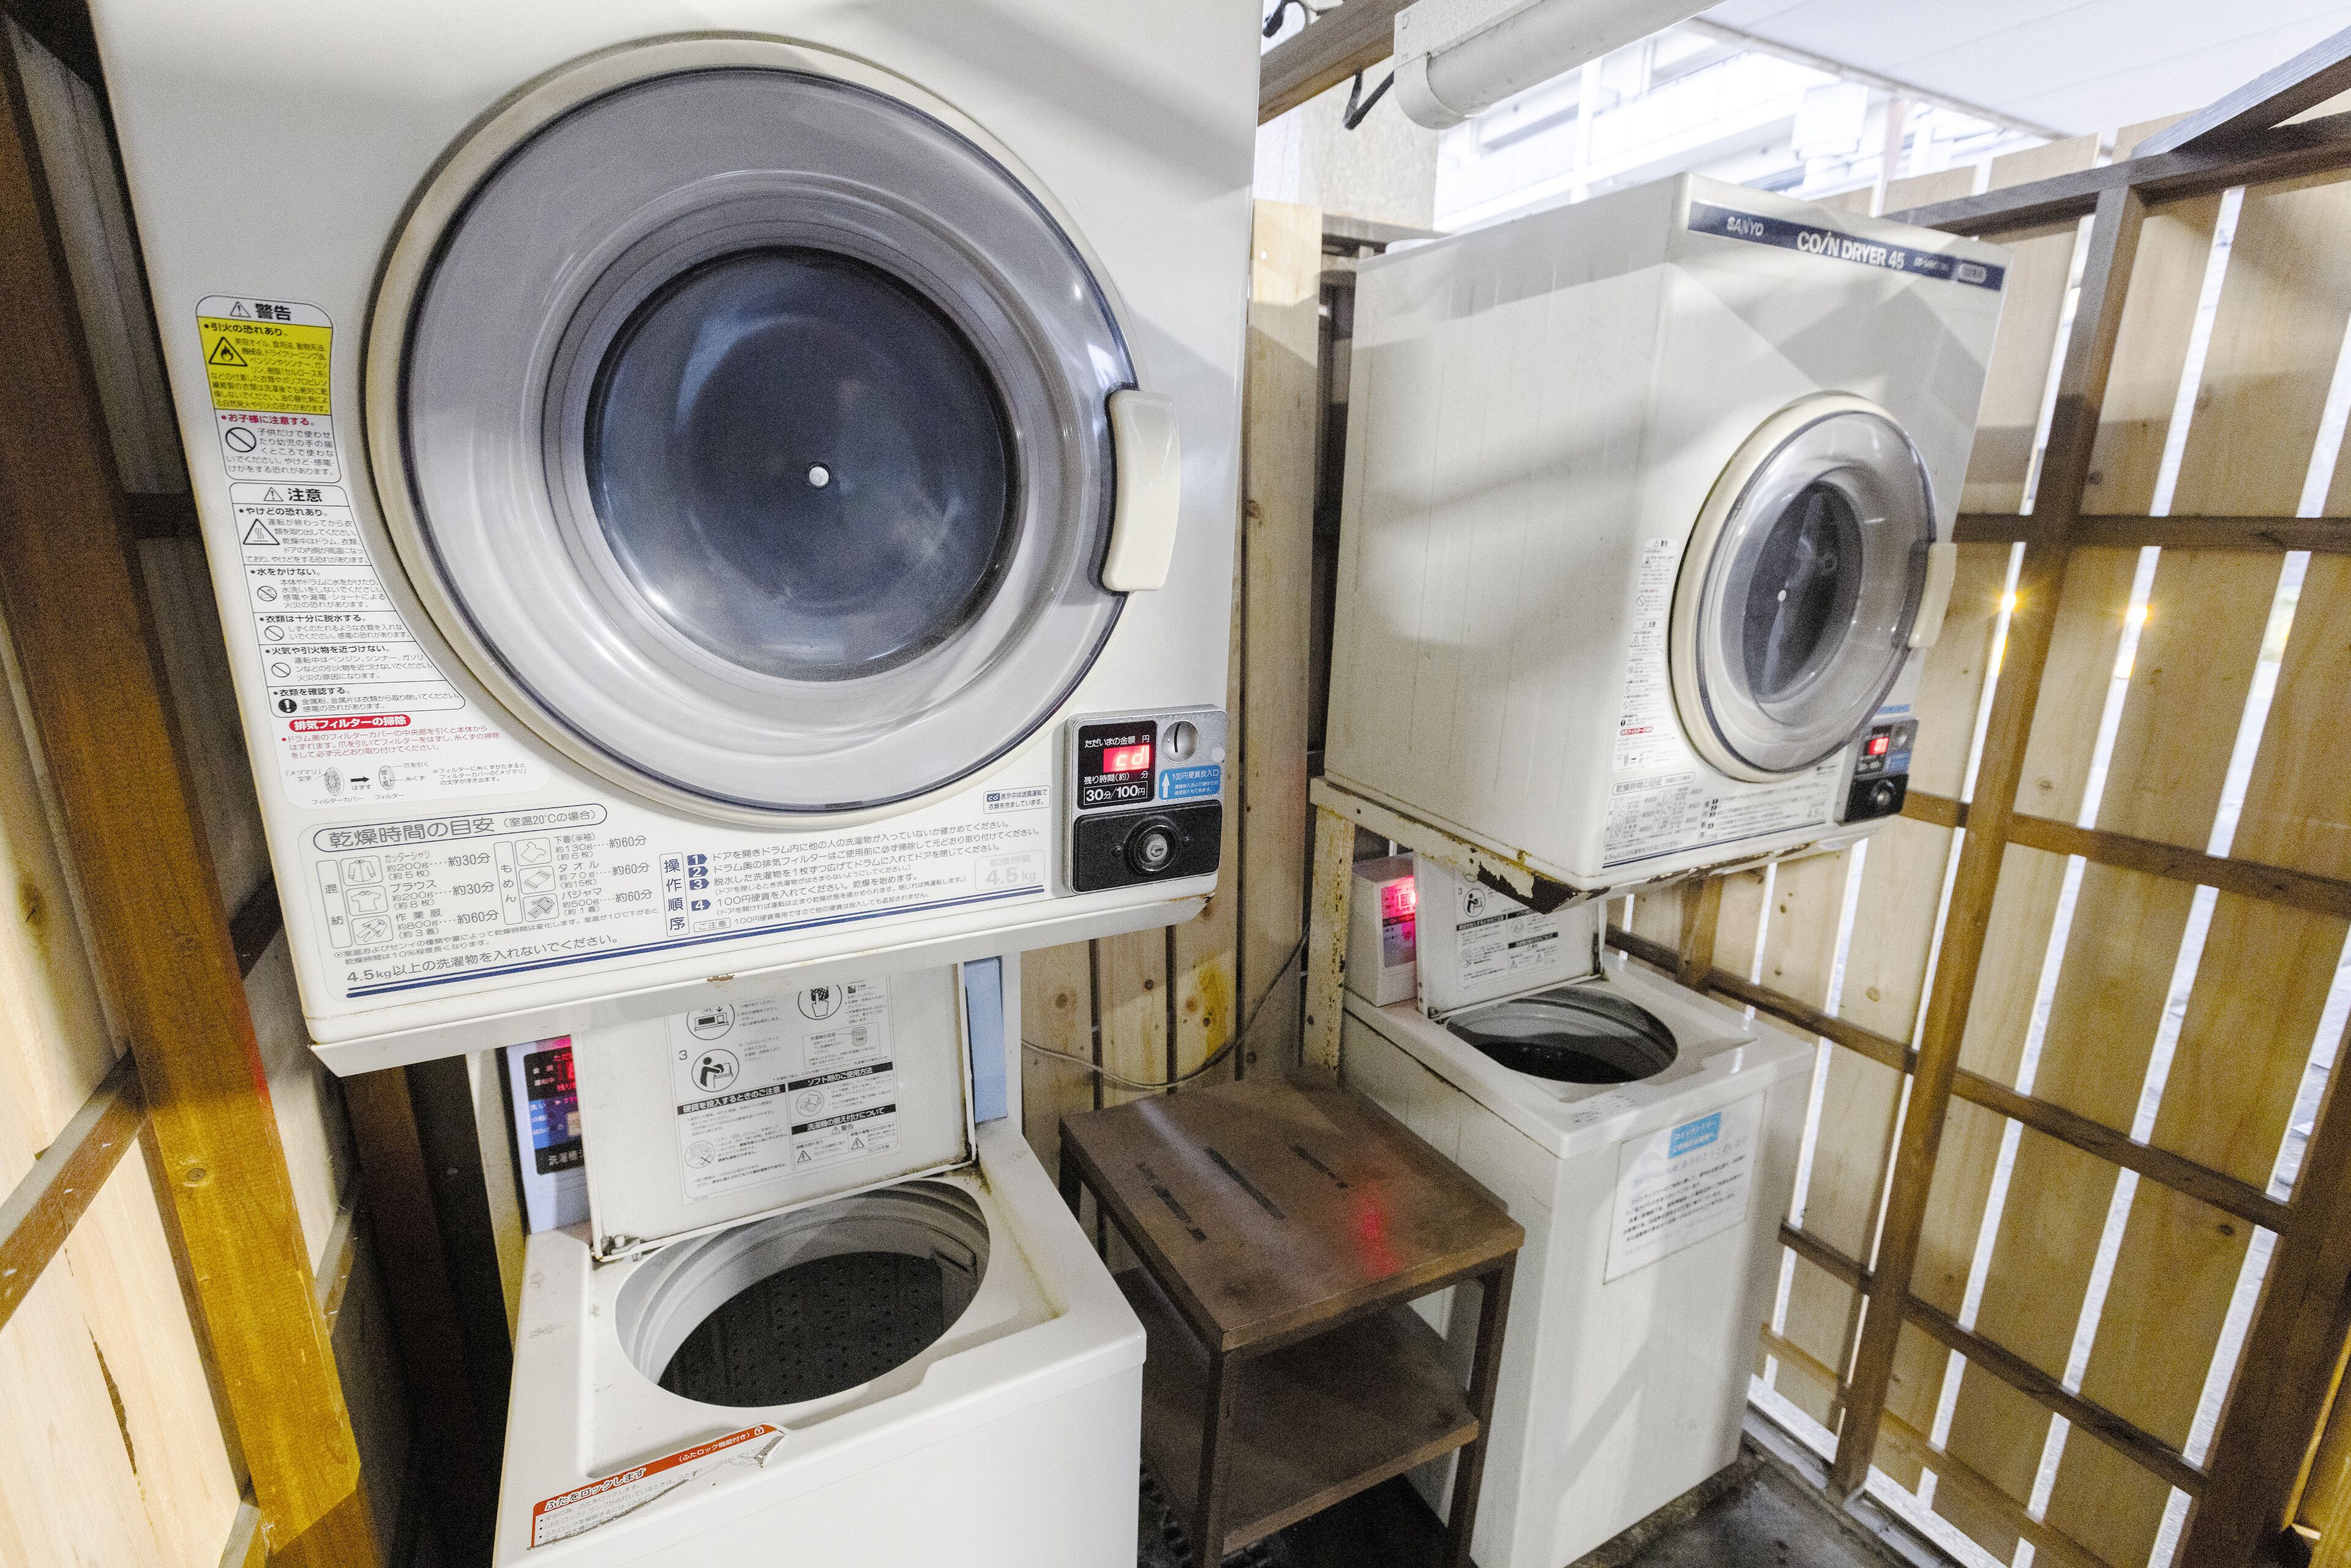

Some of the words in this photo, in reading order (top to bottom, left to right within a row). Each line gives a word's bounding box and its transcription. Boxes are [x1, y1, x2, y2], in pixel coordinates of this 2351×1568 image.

[1727, 216, 1764, 236] SANYO
[1842, 240, 1886, 267] DRYER
[1889, 251, 1905, 270] 45
[255, 302, 291, 321] 警告
[211, 321, 288, 337] 引火の恐れあり。
[228, 414, 315, 427] お子様に注意する。
[258, 429, 331, 439] 子供だけで使わせ
[259, 438, 333, 449] たり幼児の手の届
[261, 448, 334, 457] くところで使わな
[228, 465, 334, 476] けがをする恐れがあります。
[287, 487, 323, 503] 注意
[245, 506, 328, 517] やけどの恐れあり。
[268, 518, 353, 528] 運転が終わってから衣
[274, 528, 358, 536] 類を取り出してください。
[282, 537, 361, 546] 乾燥中はドラム、衣類、
[246, 555, 369, 564] ており、やけどをする恐れがあります。
[257, 568, 321, 576] 水をかけない。
[265, 613, 367, 623] 衣類は十分に脱水する。
[288, 623, 403, 632] しずくのたれるような衣類を入れな
[289, 631, 411, 640] いでください。感電の恐れがあります。
[271, 645, 390, 655] 火気や引火物を近づけない。
[294, 653, 424, 665] 運転中はベンジン、シンナー、ガソリ
[295, 662, 433, 673] ンなどの引火物を近づけないでください。
[297, 673, 381, 682] 火災の原因になります。
[279, 686, 351, 697] 衣類を確認する。
[301, 692, 460, 705] 金属粉、金属片は衣類から取り除いてください。
[302, 703, 386, 713] 感電の恐れがあります。
[293, 715, 408, 732] 排気フィルターの掃除
[287, 724, 488, 743] ドラム奥のフィルターカバーの中央部を引くと本体から
[289, 732, 501, 751] はずれます。爪を引いてフィルターをはずし、糸くずの掃除
[1084, 735, 1136, 748] ただいまの金額
[1142, 734, 1150, 743] 円
[290, 744, 440, 759] をして必ず元どおり取り付けてください。
[1083, 772, 1130, 785] 残り時間（約）
[1141, 770, 1149, 779] 分
[1172, 769, 1219, 781] 100円硬貨投入口
[1086, 785, 1146, 802] 30分/100円
[311, 797, 363, 806] フィルターカバー
[988, 800, 1044, 811] 衣類を冷ましています。
[328, 817, 495, 849] 乾燥時間の目安
[609, 835, 647, 849] 約60分
[384, 850, 430, 863] カッターシャツ
[447, 852, 491, 868] 約30分
[612, 862, 650, 876] 約60分
[985, 867, 1018, 885] 4.5
[1021, 871, 1037, 883] kg
[389, 880, 437, 893] ブラウス
[452, 881, 496, 897] 約30分
[561, 887, 602, 900] パジャマ
[615, 889, 653, 904] 約60分
[664, 858, 686, 931] 操作順序
[456, 909, 500, 925] 約60分
[698, 920, 727, 931] ご注意
[678, 1049, 688, 1060] 3
[808, 1067, 874, 1087] ソフト剤のご使用方法
[683, 1087, 781, 1113] 硬貨を投入するときのご注意
[806, 1107, 885, 1131] 洗濯機の据え付けについて
[841, 1123, 854, 1132] 警告
[544, 1468, 647, 1512] ふたをロックします
[678, 1432, 751, 1462] （ふたロック機能付き）
